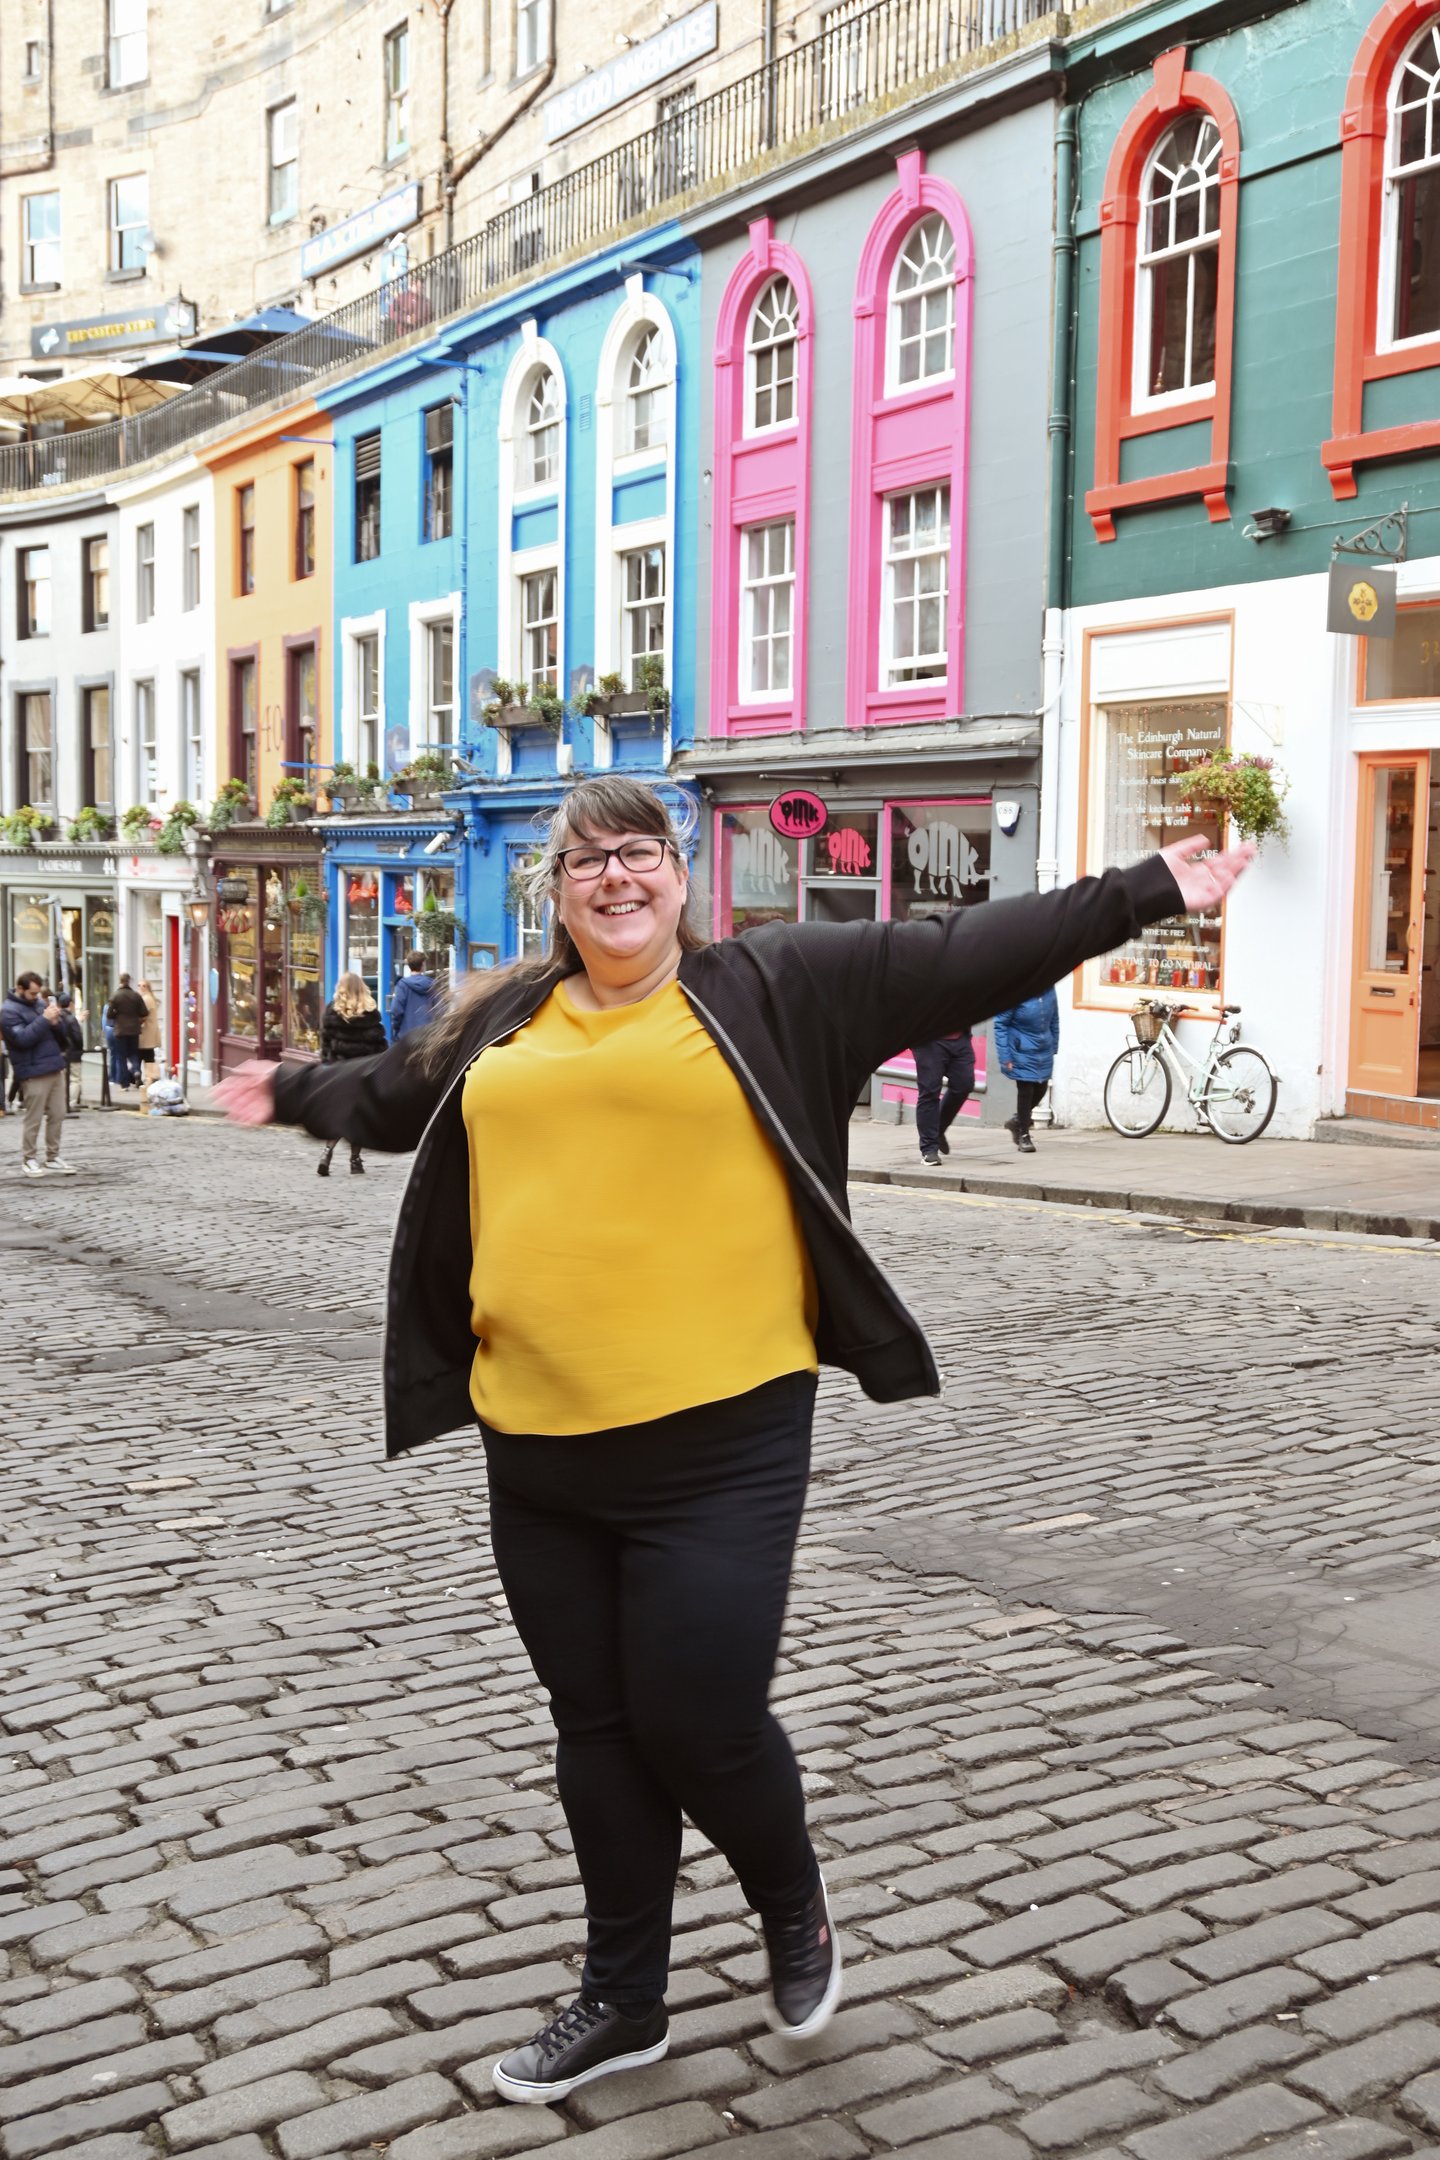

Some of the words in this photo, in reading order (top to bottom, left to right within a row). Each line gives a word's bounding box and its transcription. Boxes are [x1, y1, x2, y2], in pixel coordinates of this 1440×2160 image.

[262, 704, 284, 751] 40
[1118, 732, 1133, 744] The
[1138, 730, 1183, 745] Edinburgh
[1187, 727, 1221, 741] Natural
[1127, 748, 1162, 760] Skincare
[1166, 745, 1207, 761] Company
[1170, 929, 1185, 937] FREE
[1149, 959, 1160, 969] TO
[1160, 959, 1174, 970] GO
[1175, 960, 1214, 971] NATURAL
